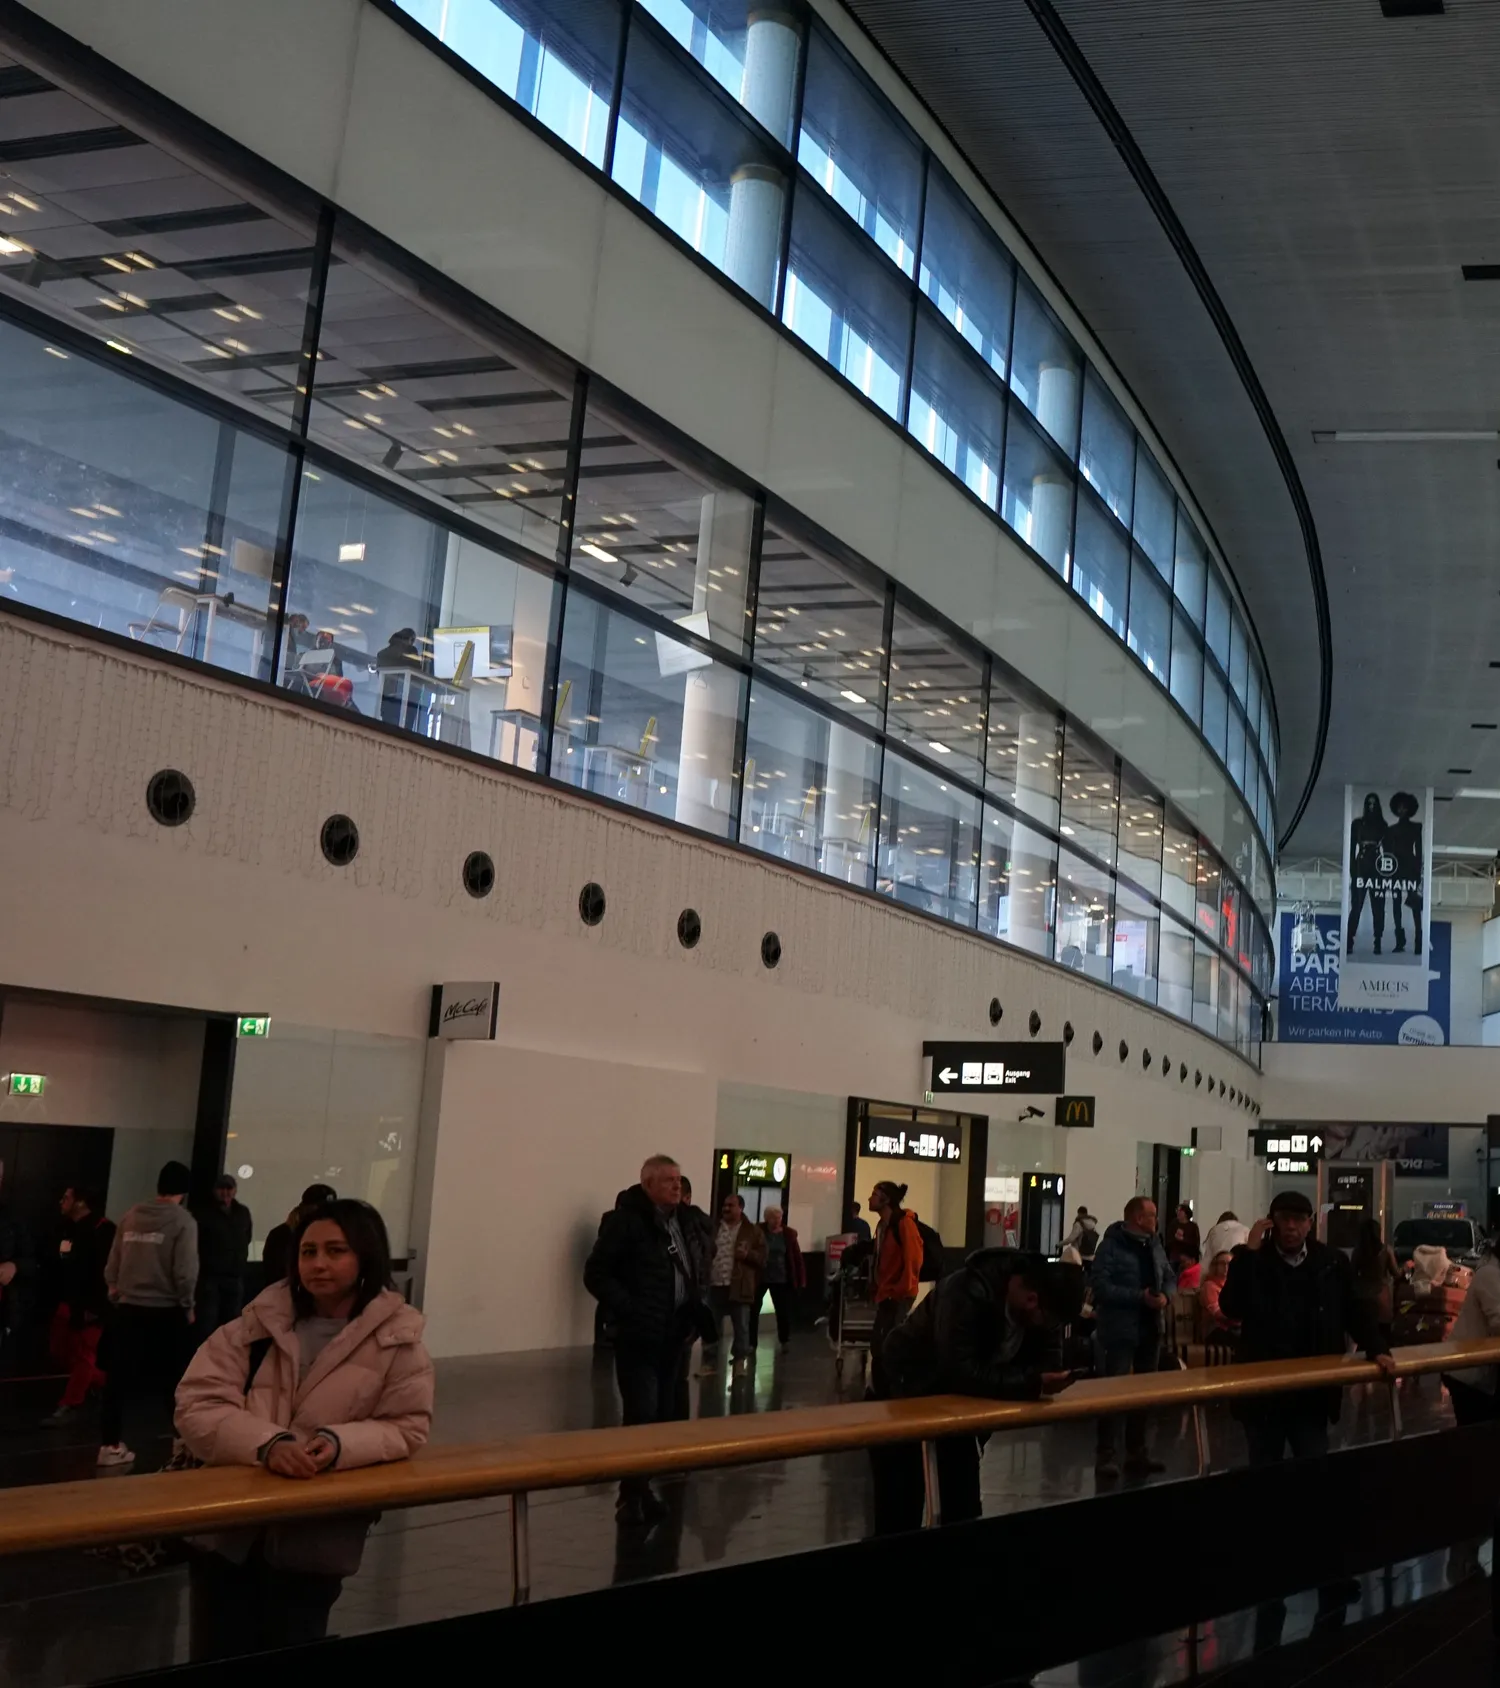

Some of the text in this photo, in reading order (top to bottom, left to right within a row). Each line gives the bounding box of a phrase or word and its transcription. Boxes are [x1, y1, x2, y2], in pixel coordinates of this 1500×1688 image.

[1356, 878, 1417, 892] BALMAIN
[1374, 891, 1398, 899] PARIS
[1290, 953, 1340, 974] PAR
[1359, 980, 1409, 992] AMICIS
[1289, 1025, 1306, 1036] Wir
[1308, 1027, 1342, 1039] parken
[1344, 1028, 1357, 1037] Ihr
[1005, 1070, 1031, 1079] Ausgang
